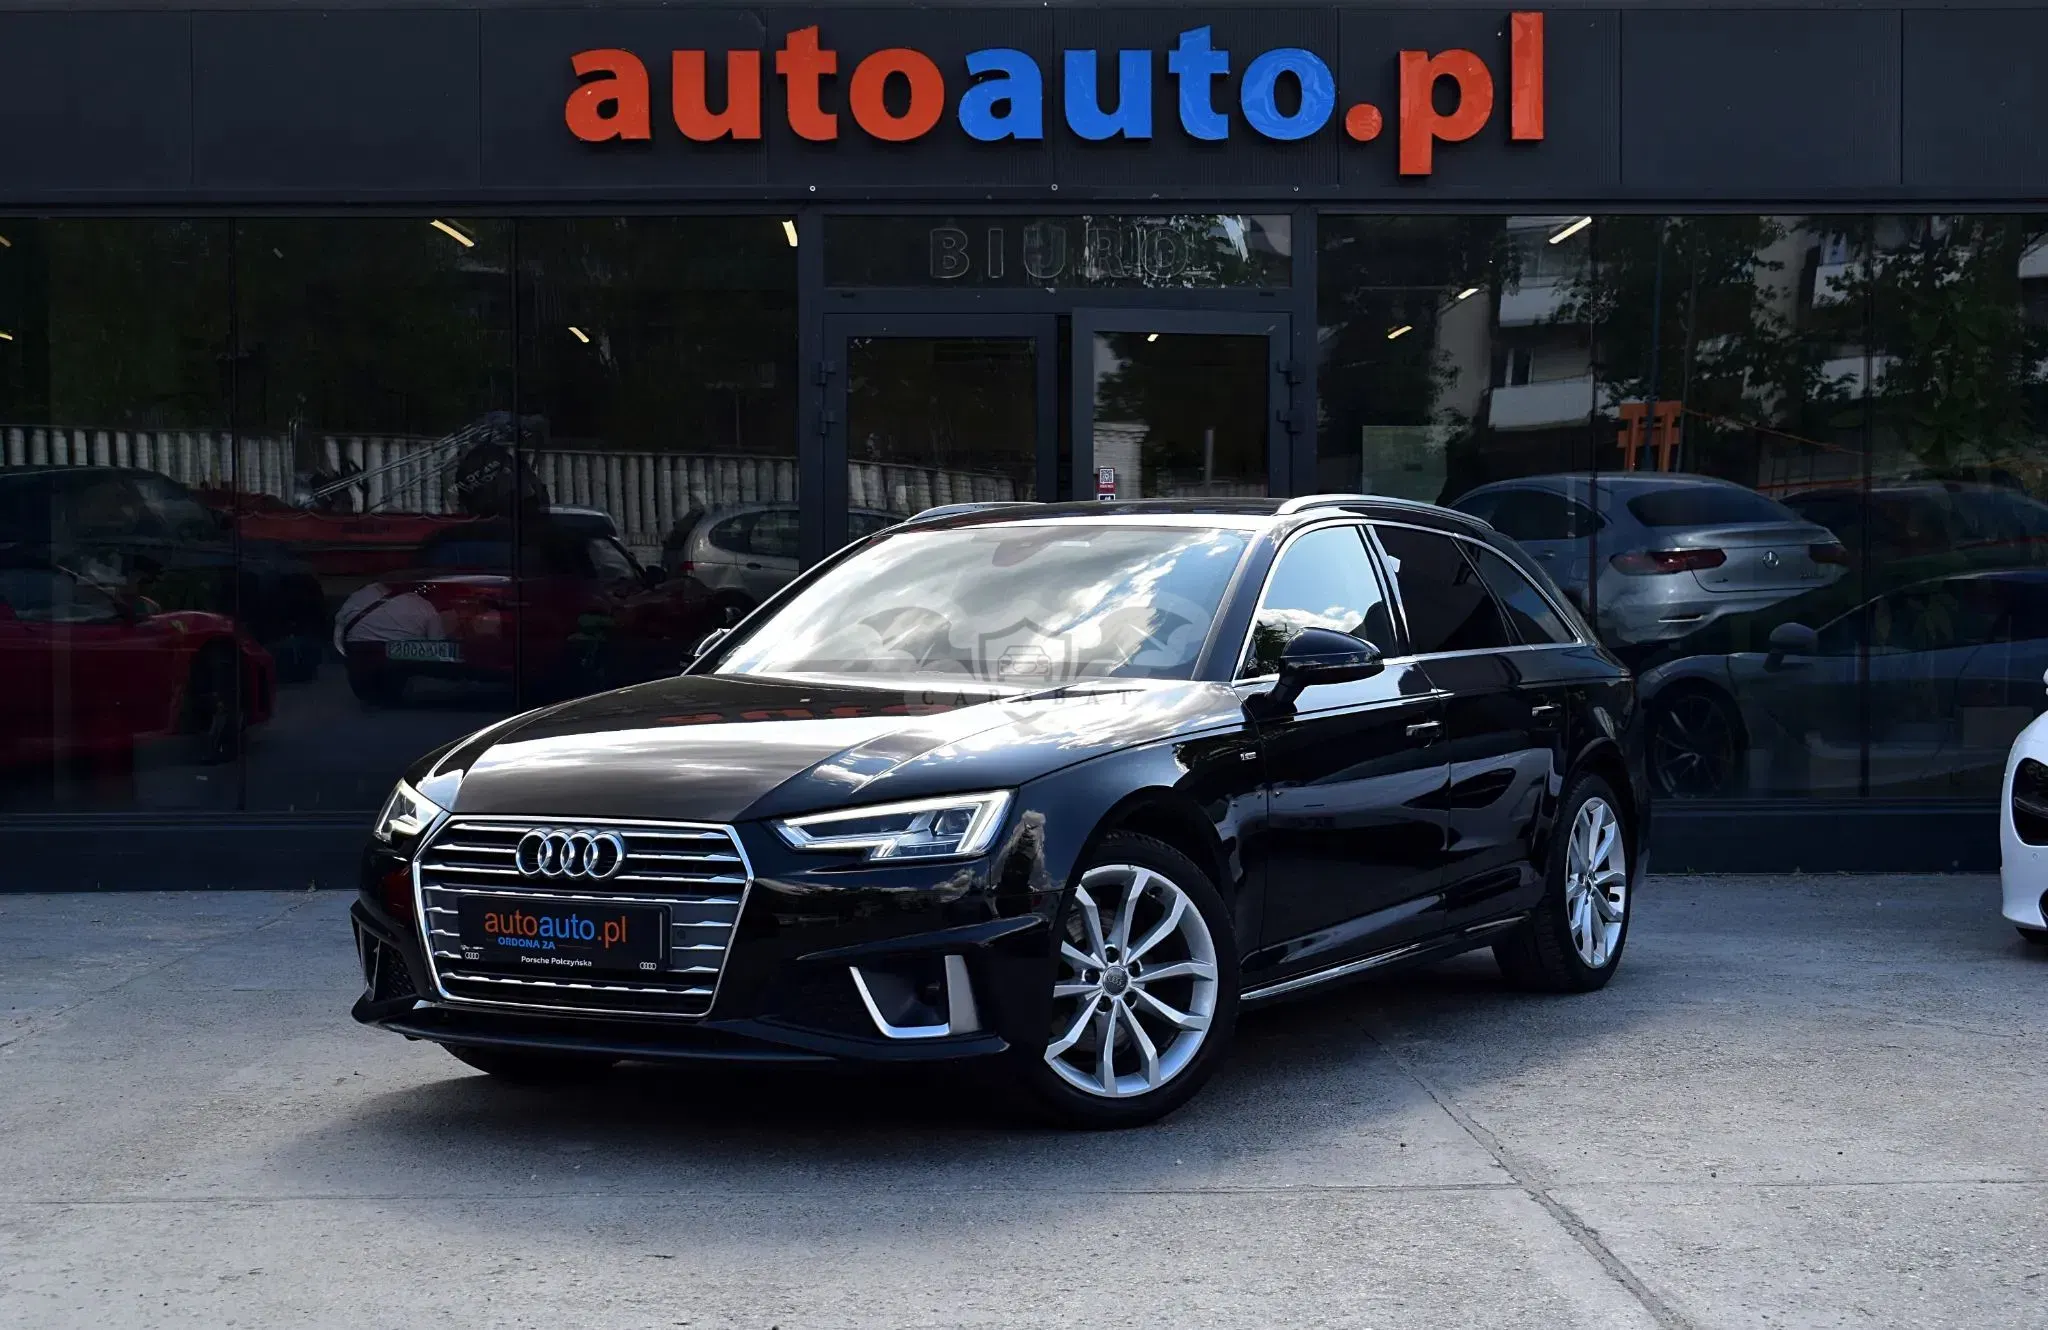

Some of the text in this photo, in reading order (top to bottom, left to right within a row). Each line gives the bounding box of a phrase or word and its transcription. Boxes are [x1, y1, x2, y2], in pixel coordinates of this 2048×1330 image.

[564, 12, 1544, 174] autoauto.pl
[930, 228, 1187, 278] BIURO
[484, 909, 627, 948] autoauto.pl
[498, 937, 540, 949] ORDONA
[521, 955, 550, 964] Porsche
